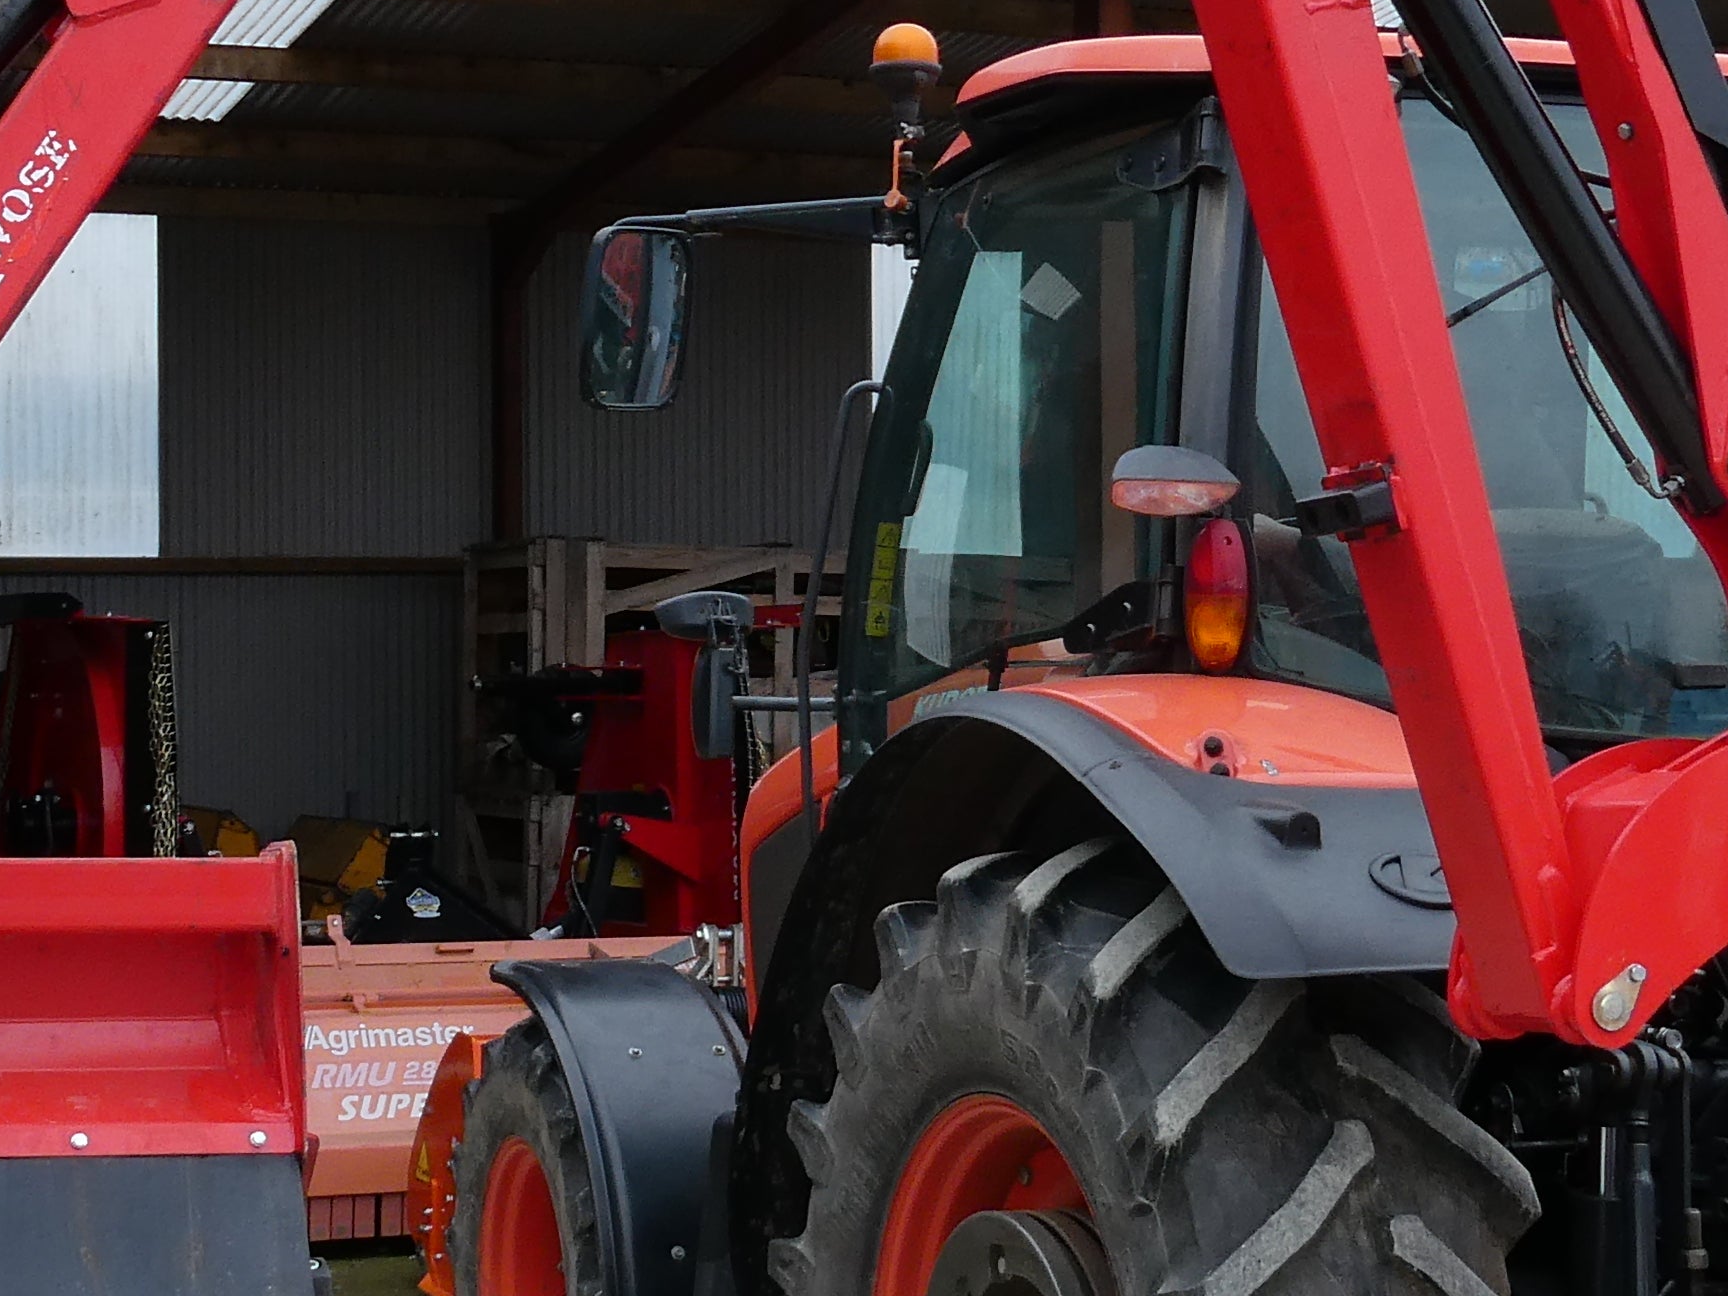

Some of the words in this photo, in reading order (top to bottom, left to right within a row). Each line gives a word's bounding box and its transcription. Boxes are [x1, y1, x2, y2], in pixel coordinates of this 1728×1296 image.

[311, 1061, 397, 1088] RMU
[403, 1060, 437, 1085] 28
[338, 1092, 429, 1121] SUPE
